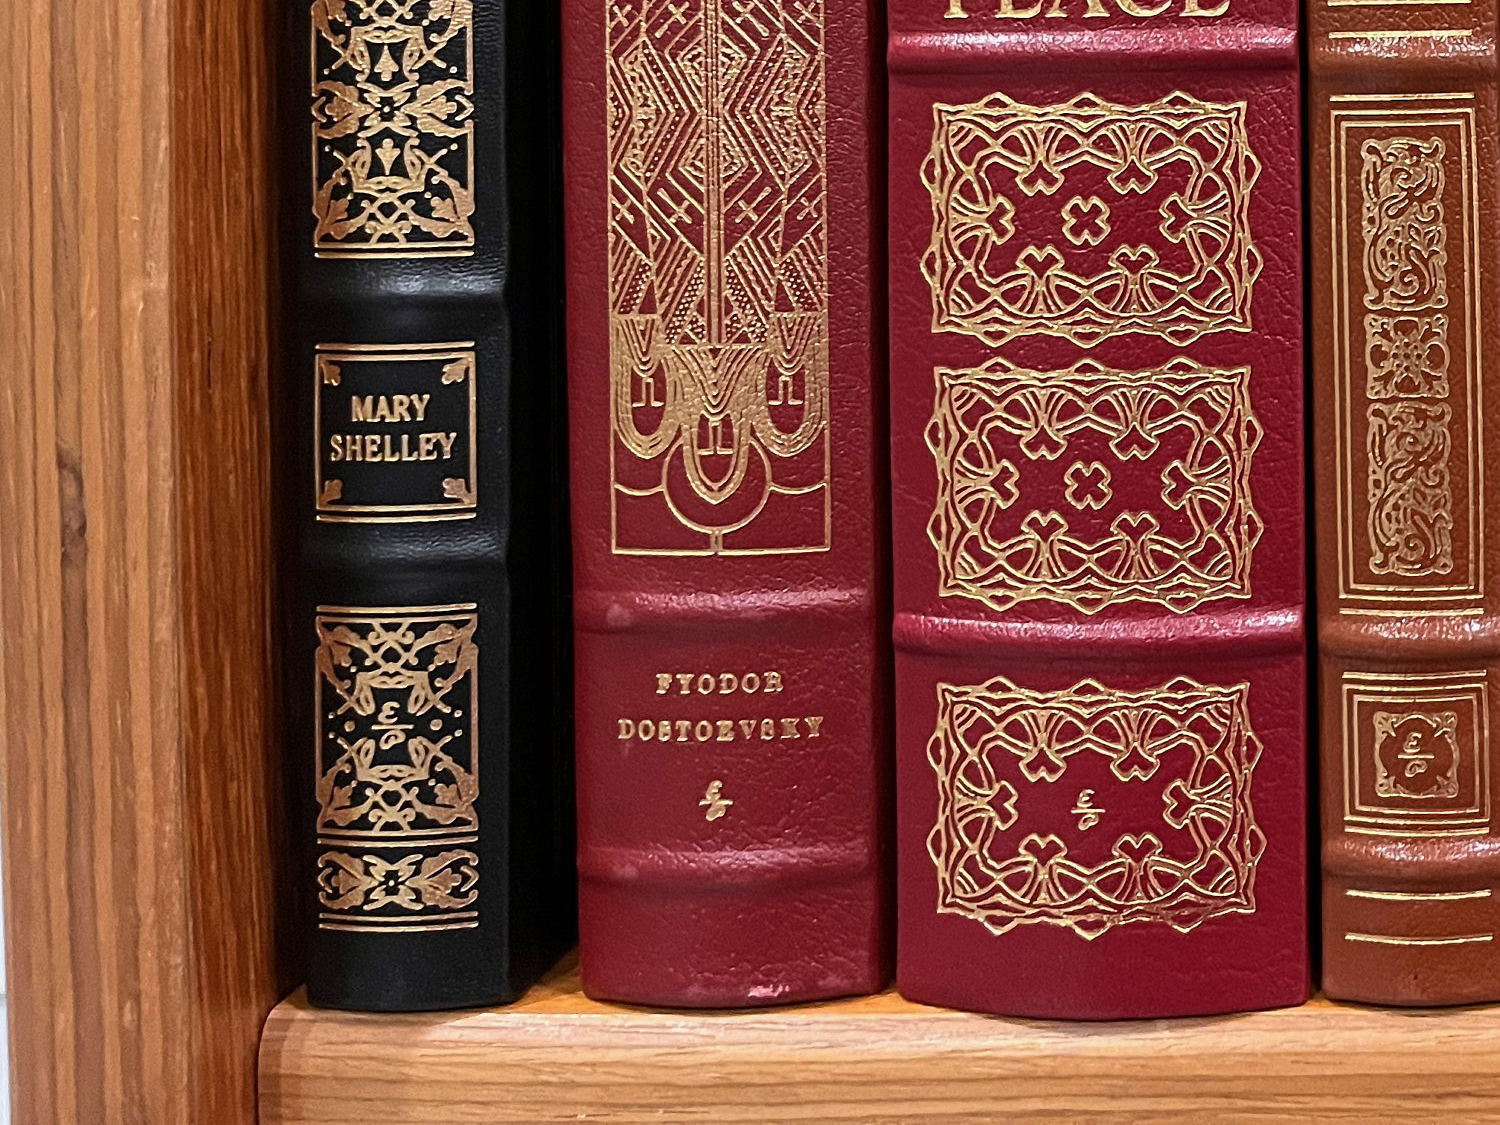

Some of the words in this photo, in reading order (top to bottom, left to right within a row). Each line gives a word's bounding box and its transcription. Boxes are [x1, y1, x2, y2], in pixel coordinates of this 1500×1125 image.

[351, 393, 430, 423] MARY
[330, 431, 457, 463] SHELLEY
[655, 671, 784, 695] FYODOR
[617, 716, 824, 742] DOSTOEVSKY
